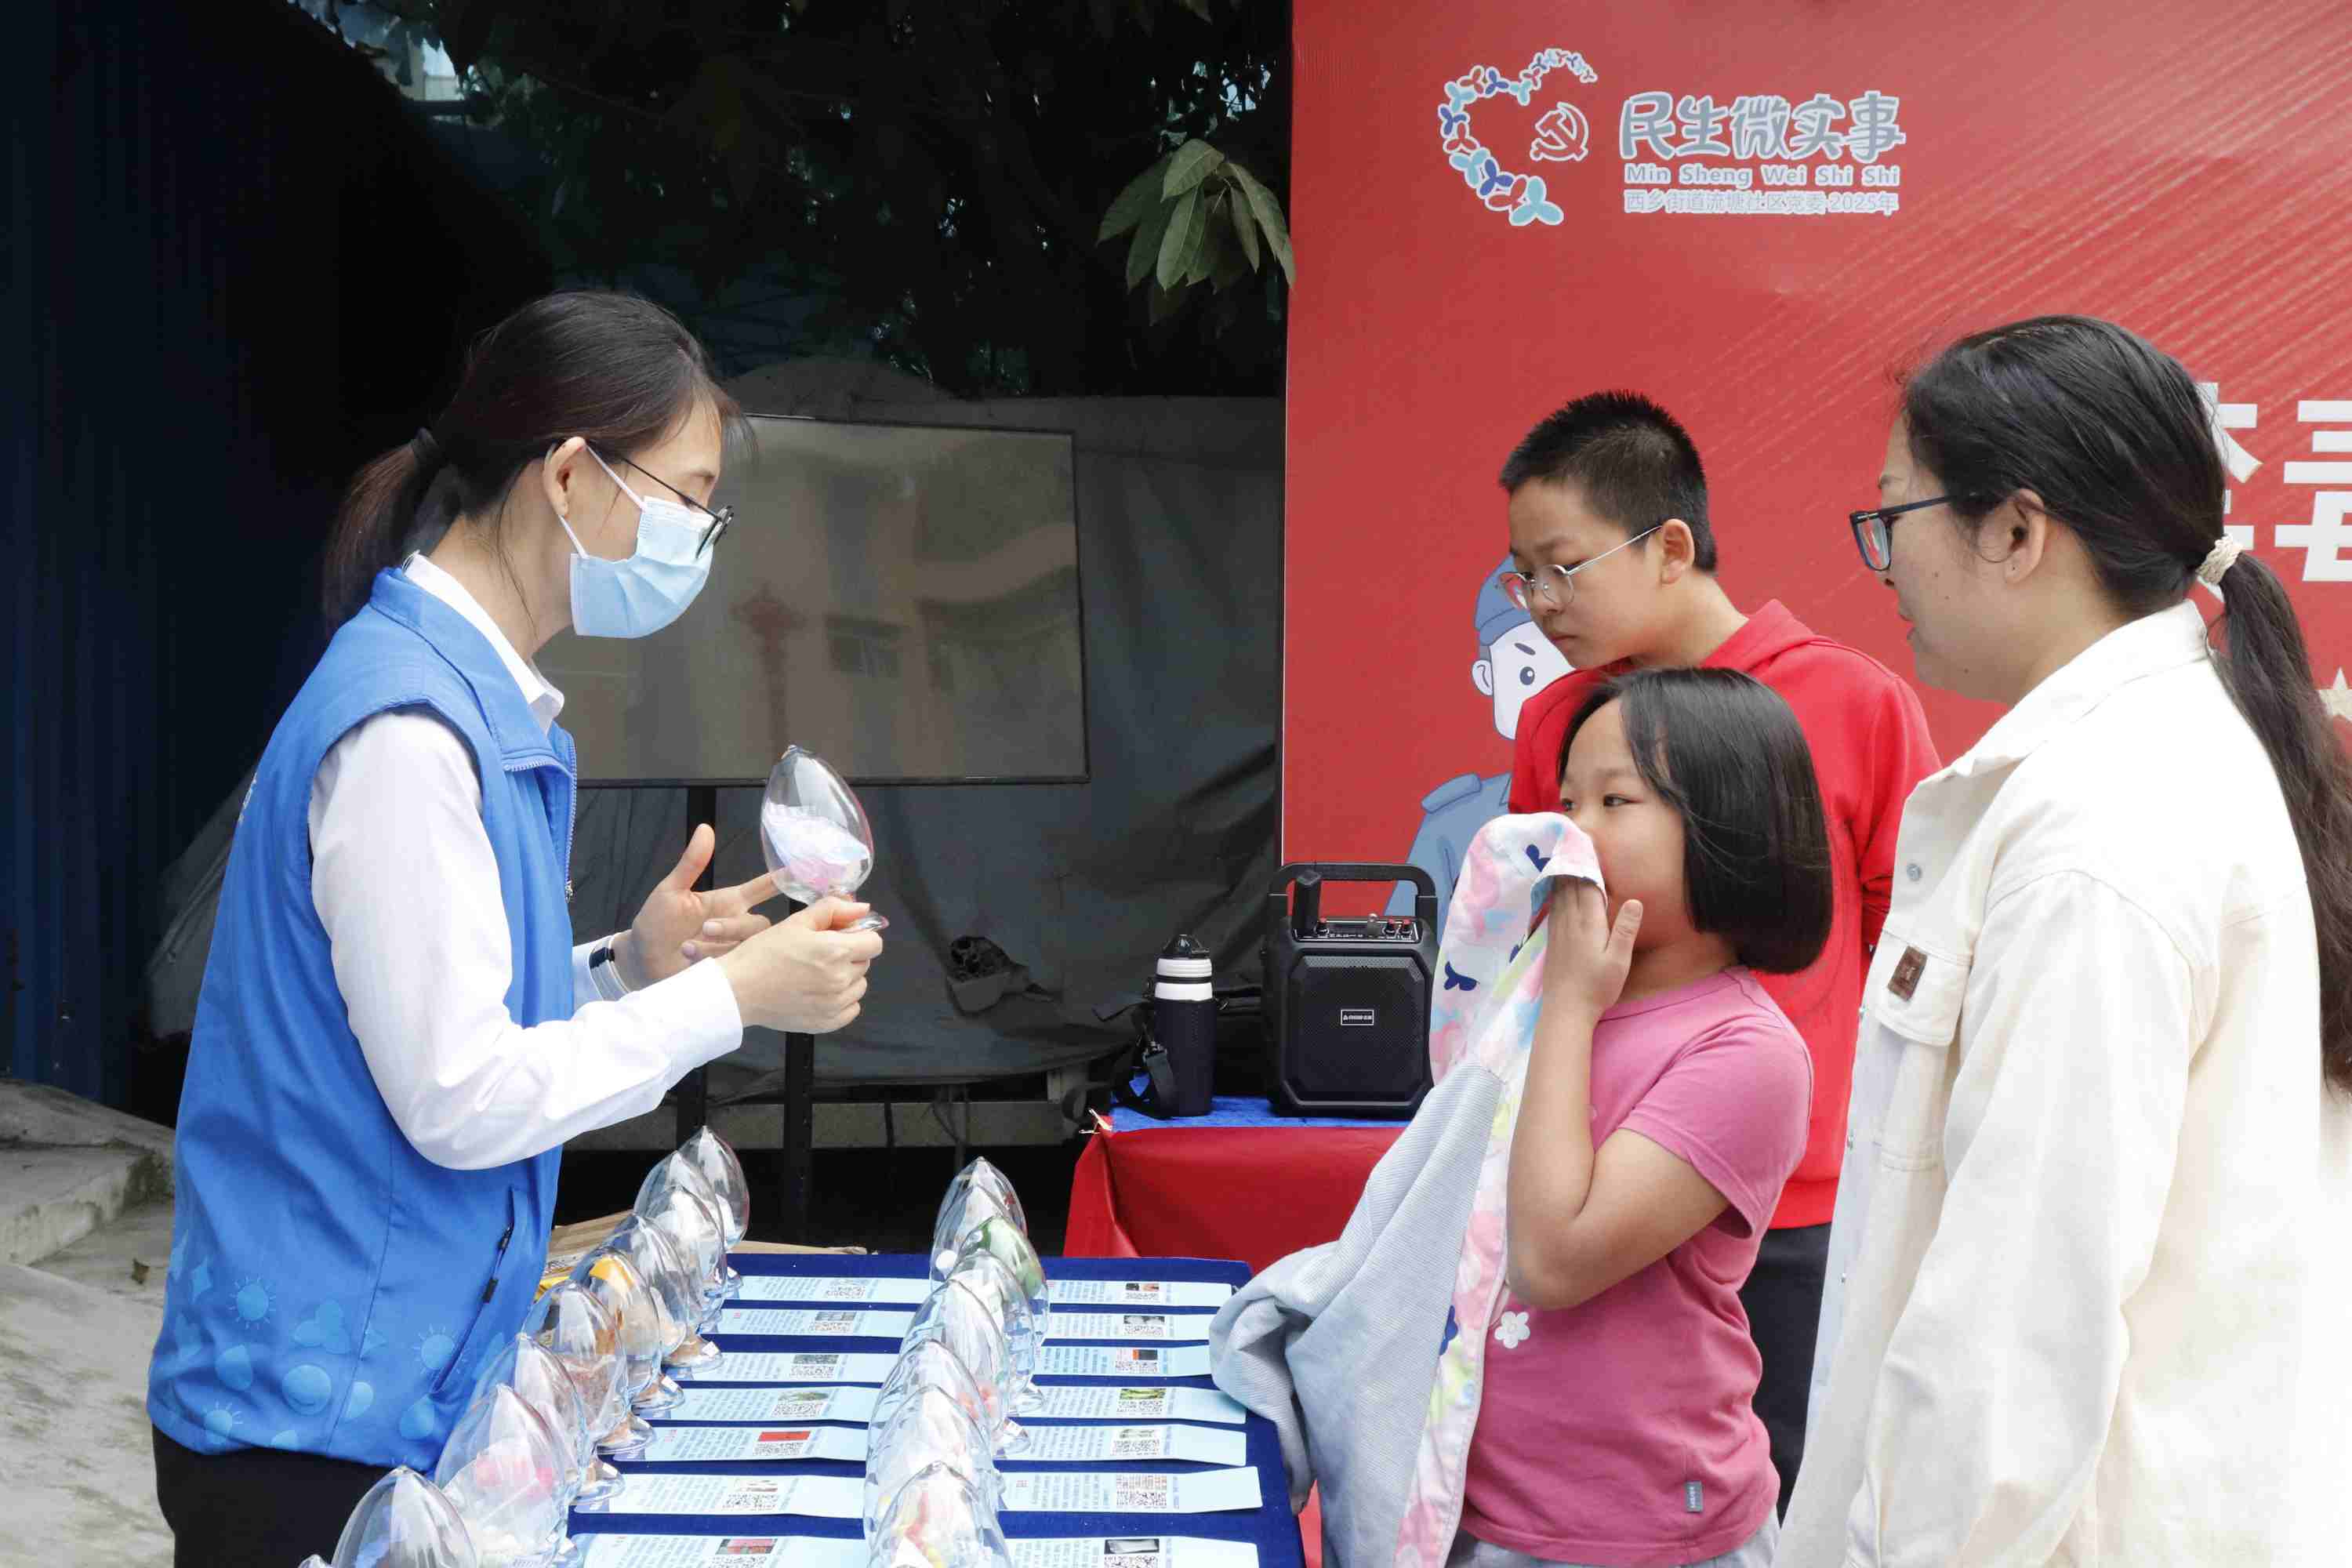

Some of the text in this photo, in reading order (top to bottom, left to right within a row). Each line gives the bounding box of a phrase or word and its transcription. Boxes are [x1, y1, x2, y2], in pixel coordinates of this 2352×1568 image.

[1621, 92, 1906, 162] 民生微实事
[1625, 164, 1900, 188] Min Sheng Wei Shi Shi
